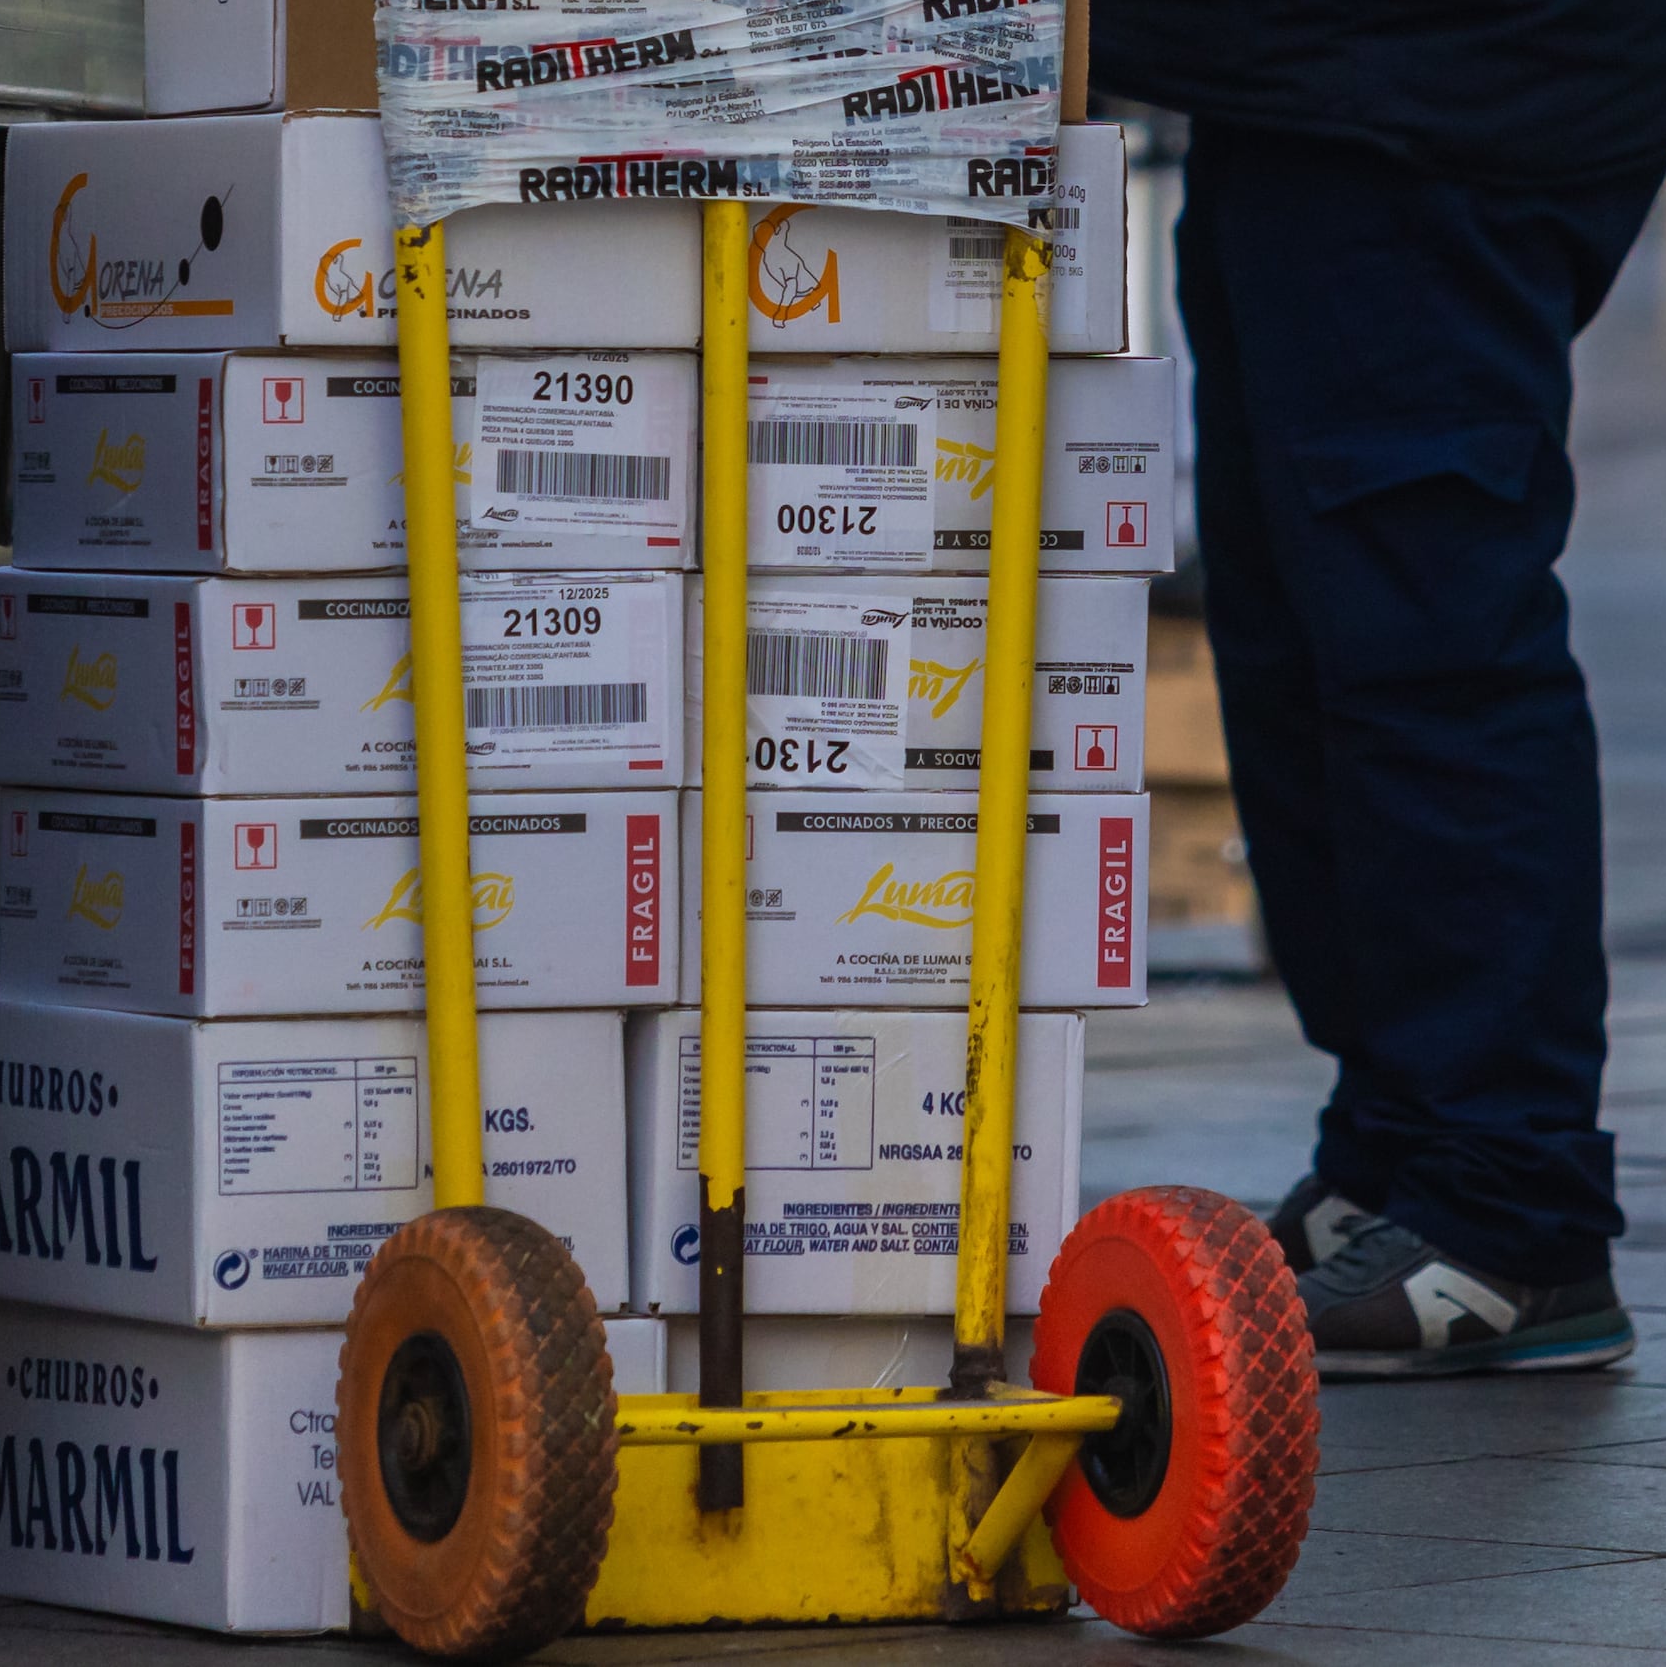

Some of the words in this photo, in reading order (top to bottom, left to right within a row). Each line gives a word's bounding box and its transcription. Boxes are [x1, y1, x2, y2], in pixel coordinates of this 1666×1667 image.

[774, 6, 844, 25] YELES-TOLEDO
[477, 29, 697, 94] RADITHERM
[705, 94, 717, 103] La
[833, 138, 844, 147] La
[846, 138, 883, 148] Estación
[819, 158, 889, 168] YELES-TOLEDO
[520, 153, 738, 204] RADITHERM
[742, 183, 770, 197] S.L.
[855, 169, 871, 178] 673
[1068, 185, 1086, 202] 40g
[532, 370, 634, 405] 21390
[944, 398, 960, 410] DE
[199, 401, 210, 526] FRAGIL
[777, 503, 878, 535] 21300
[558, 587, 610, 601] 12/2025
[325, 602, 411, 617] COCINADO
[503, 606, 601, 638] 21309
[911, 616, 927, 628] DE
[932, 616, 982, 631] COCIÑA
[178, 625, 192, 751] FRAGIL
[361, 742, 371, 753] A
[746, 736, 851, 774] 2130
[916, 752, 925, 765] Y
[327, 820, 419, 836] COCINADOS
[469, 817, 561, 832] COCINADOS
[803, 816, 894, 830] COCINADOS
[902, 817, 911, 830] Y
[919, 817, 1035, 831] PRECOCS
[632, 837, 654, 962] FRAGIL
[834, 862, 978, 930] Luma
[1104, 839, 1127, 963] FRAGIL
[182, 848, 193, 970] FRAGIL
[362, 961, 372, 972] A
[492, 958, 513, 968] S.L.
[836, 954, 846, 966] A
[849, 952, 900, 966] COCIÑA
[903, 954, 919, 966] DE
[923, 954, 962, 966] LUMAI
[837, 975, 852, 984] 986
[746, 1044, 798, 1053] NUTRICIONAL
[922, 1091, 934, 1115] 4
[940, 1091, 967, 1116] KG
[484, 1107, 535, 1133] KGS.
[879, 1144, 943, 1161] NRGSAA
[492, 1158, 577, 1176] 2601972/TO
[783, 1203, 873, 1217] INGREDIENTES
[770, 1222, 786, 1235] DE
[789, 1222, 830, 1238] TRIGO,
[833, 1222, 870, 1236] AGUA
[871, 1222, 880, 1235] Y
[882, 1222, 909, 1235] SAL.
[911, 1222, 960, 1236] CONTIE
[263, 1245, 311, 1262] HARINA
[313, 1245, 331, 1259] DE
[333, 1243, 375, 1259] TRIGO,
[763, 1239, 805, 1255] FLOUR,
[808, 1239, 850, 1253] WATER
[851, 1239, 879, 1253] AND
[880, 1238, 910, 1253] SALT.
[262, 1262, 303, 1277] WHEAT
[306, 1260, 349, 1277] FLOUR,
[296, 1482, 335, 1507] VAL
